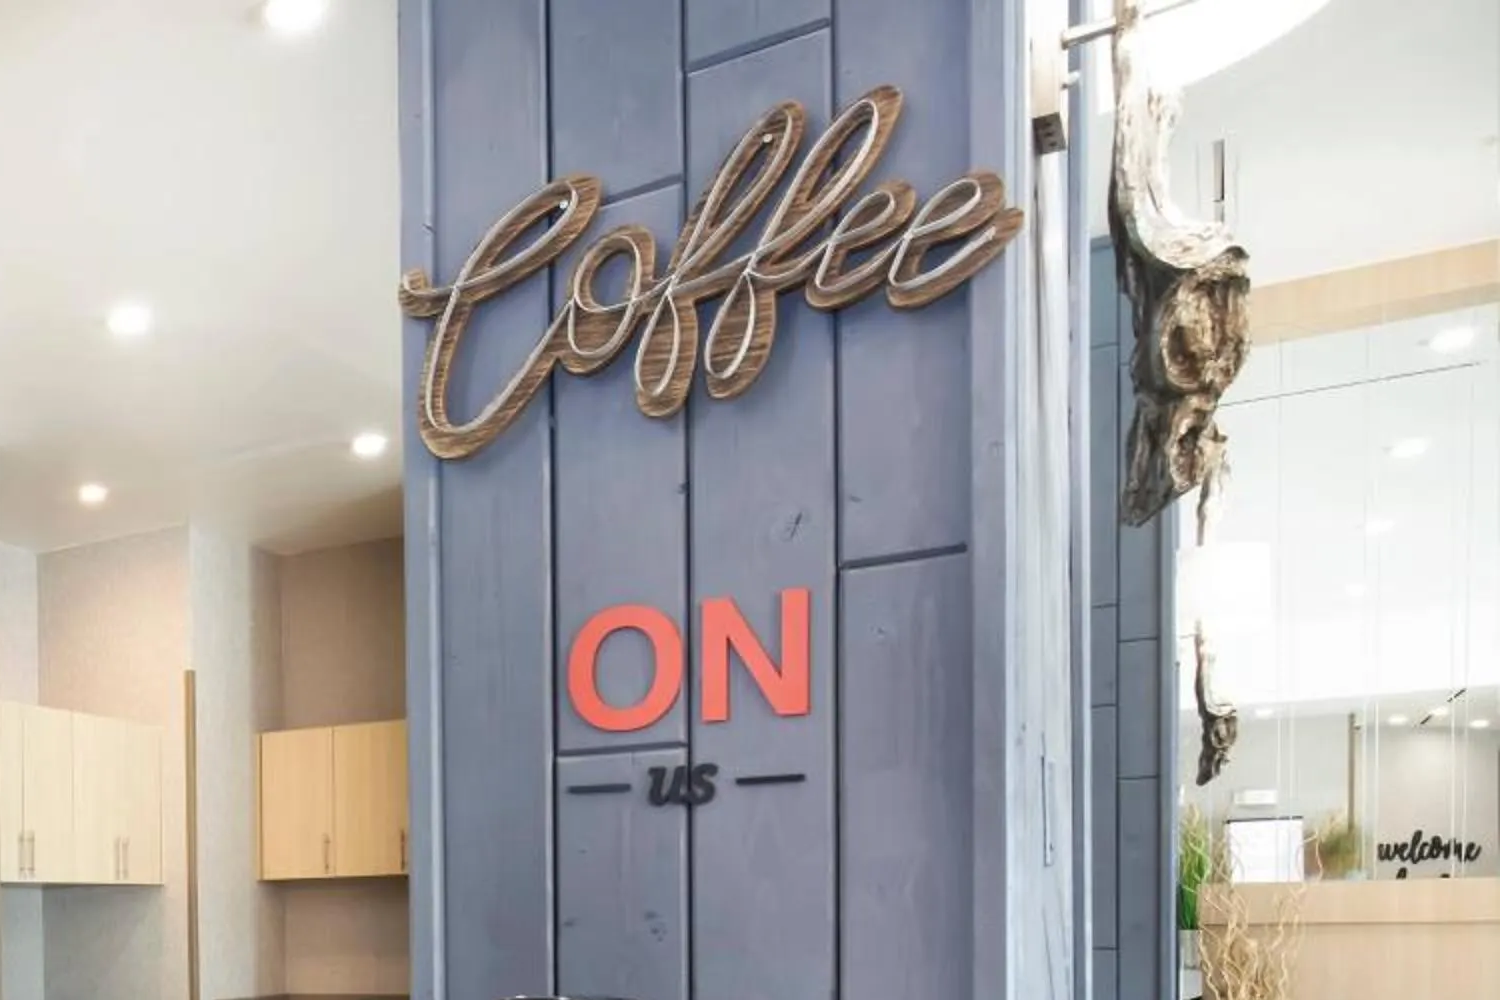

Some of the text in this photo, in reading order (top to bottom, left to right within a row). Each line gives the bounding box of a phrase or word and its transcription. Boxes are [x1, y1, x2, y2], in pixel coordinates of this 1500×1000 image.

[400, 84, 1024, 461] Coffee
[566, 587, 811, 733] ON
[646, 762, 718, 807] us
[1377, 829, 1482, 865] welcome
